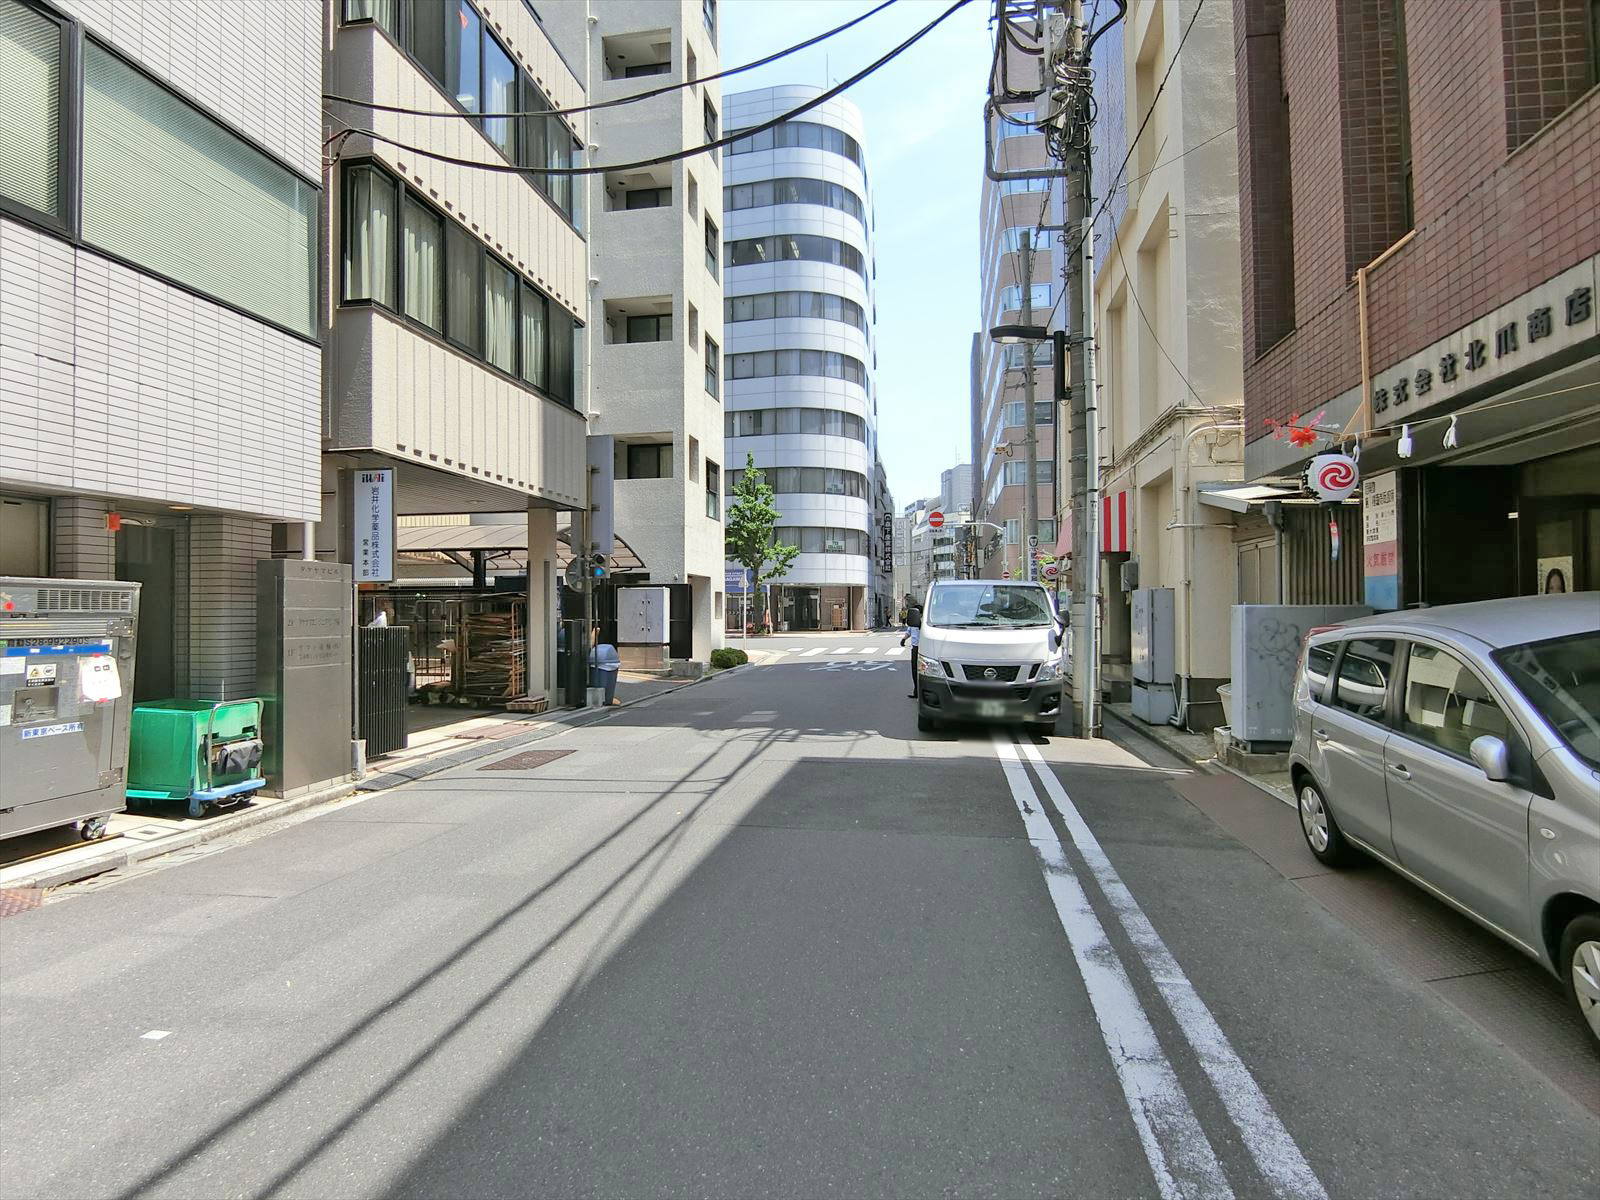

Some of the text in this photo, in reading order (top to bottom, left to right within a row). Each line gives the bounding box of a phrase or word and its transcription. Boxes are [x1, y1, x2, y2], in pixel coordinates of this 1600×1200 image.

[1374, 286, 1592, 413] 株式会社北爪商店
[362, 538, 370, 577] 営業本部
[371, 486, 380, 578] 岩井化学薬品株式会社
